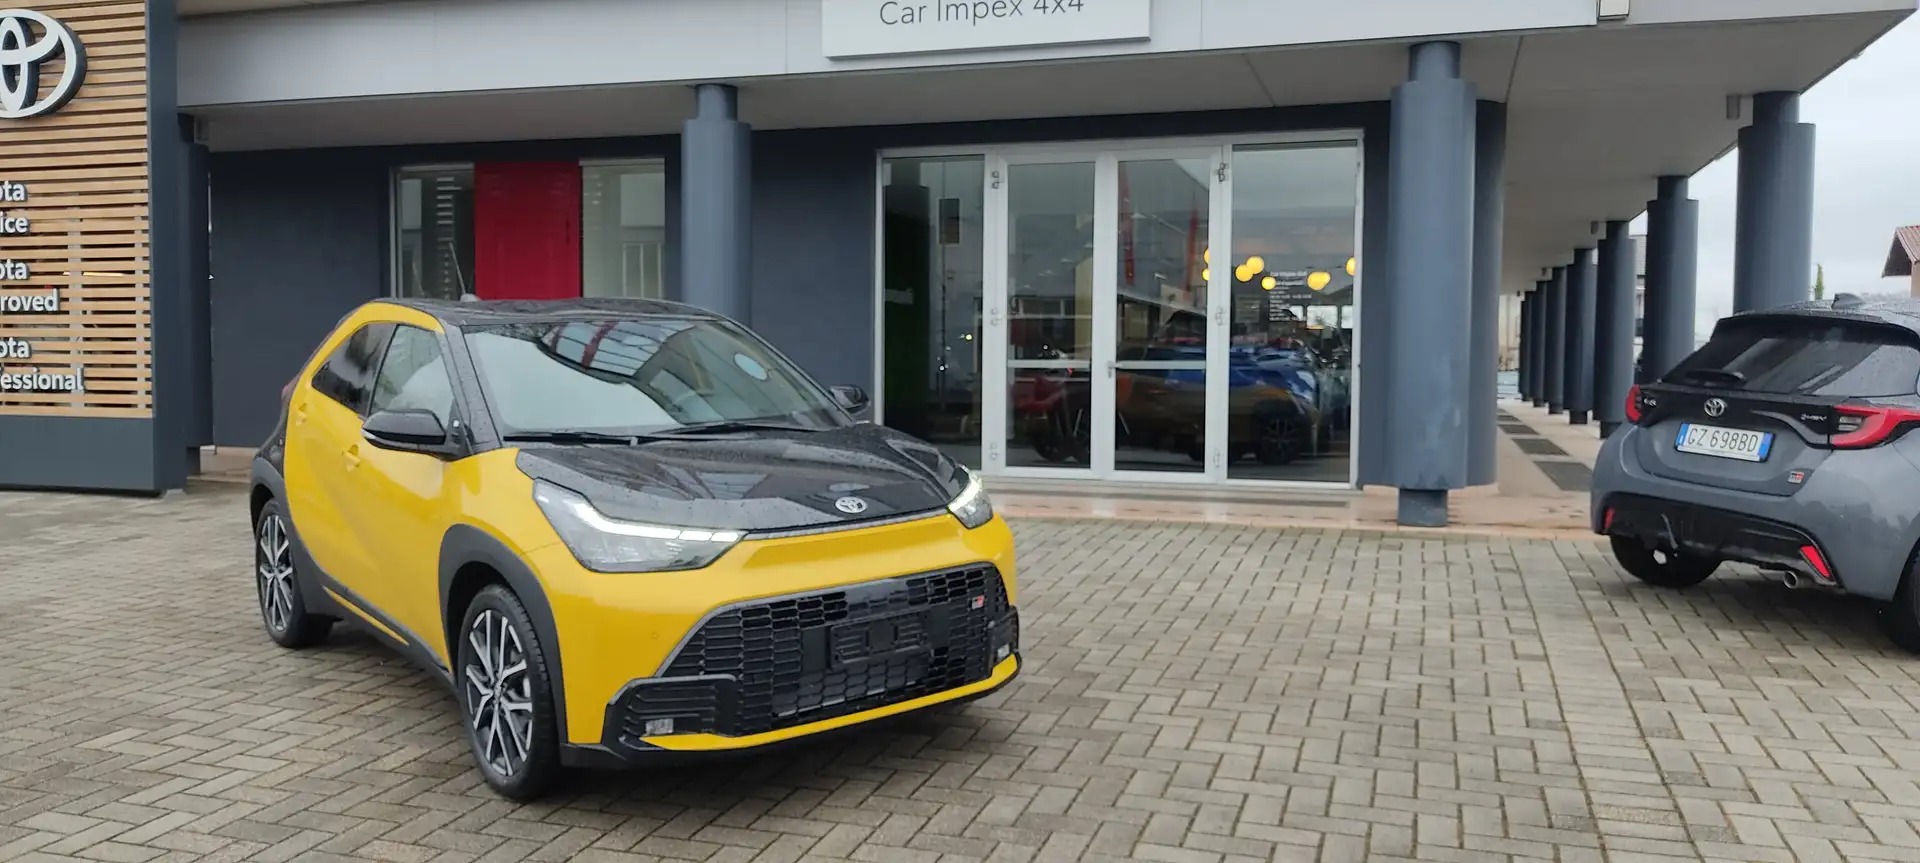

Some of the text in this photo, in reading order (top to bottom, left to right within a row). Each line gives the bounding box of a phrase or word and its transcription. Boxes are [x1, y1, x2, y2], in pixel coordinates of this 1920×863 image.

[880, 1, 927, 25] Car
[938, 0, 1023, 26] Impex
[0, 367, 84, 390] essional
[1710, 430, 1758, 452] 698BD
